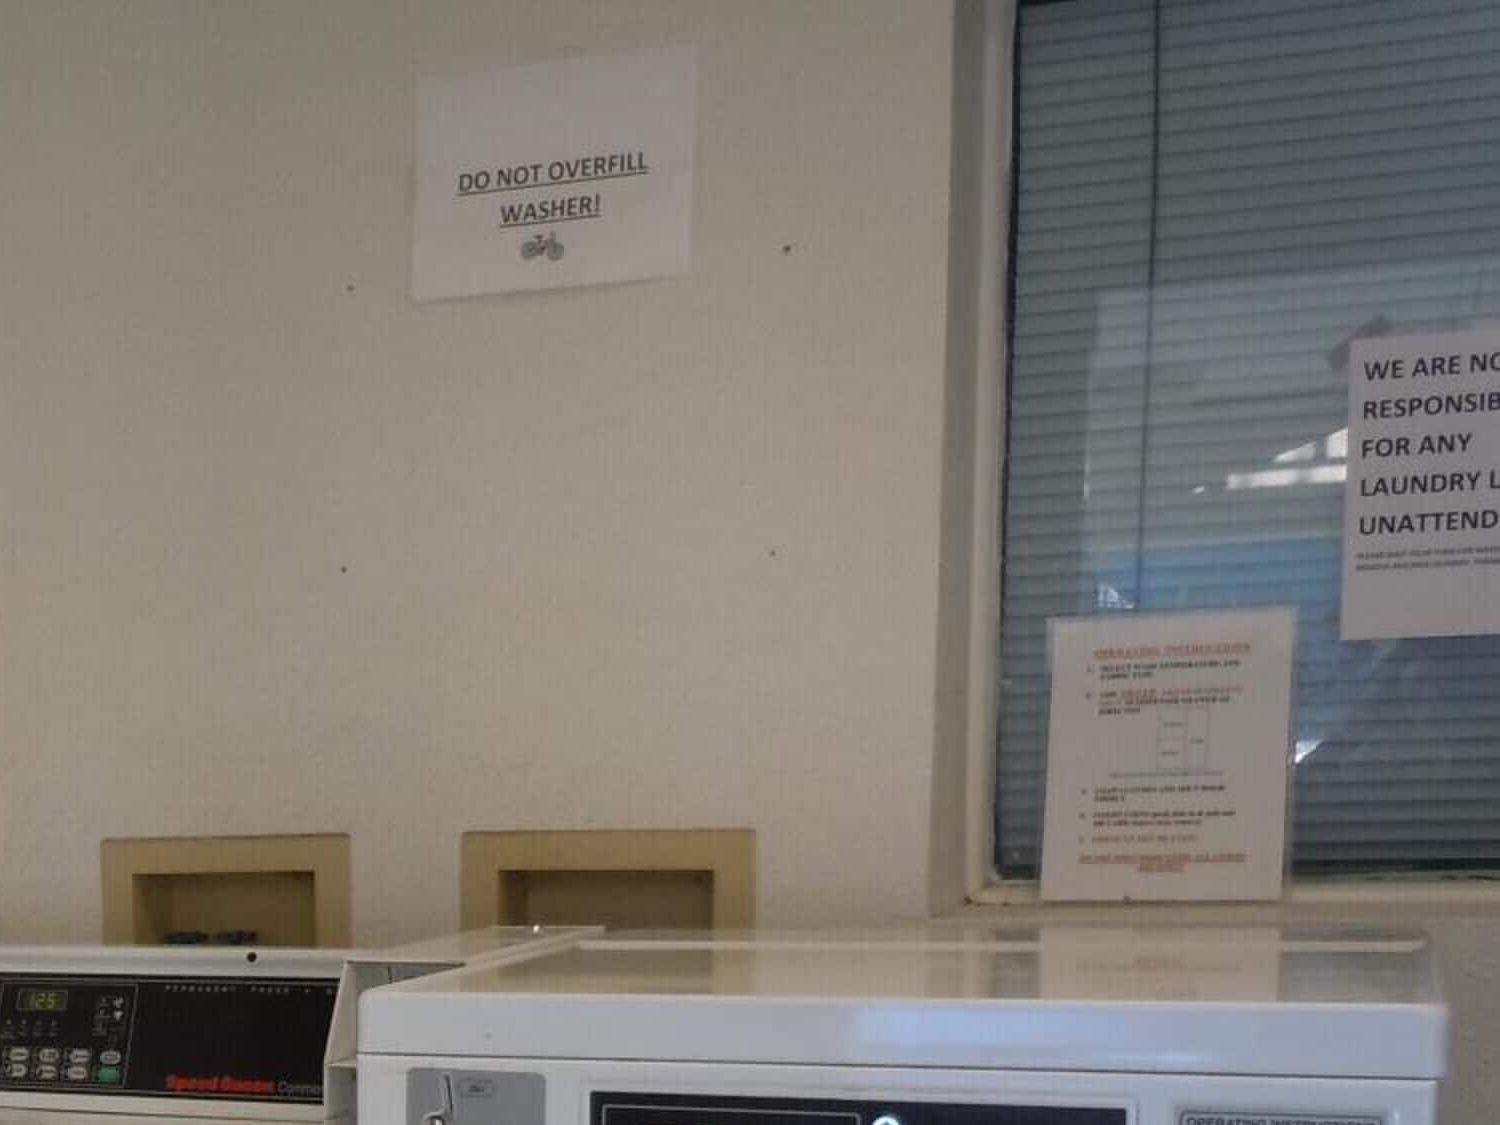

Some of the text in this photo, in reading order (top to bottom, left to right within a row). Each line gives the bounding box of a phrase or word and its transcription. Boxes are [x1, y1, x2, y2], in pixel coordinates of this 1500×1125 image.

[458, 152, 648, 192] DO NOT OVERFILL
[500, 194, 601, 224] WASHER!
[1363, 359, 1404, 381] WE
[1411, 355, 1461, 377] ARE
[1363, 392, 1500, 420] RESPONSIB
[1361, 432, 1473, 459] FOR ANY
[1360, 471, 1482, 497] LAUNDRY
[1359, 509, 1499, 536] UNATTEND
